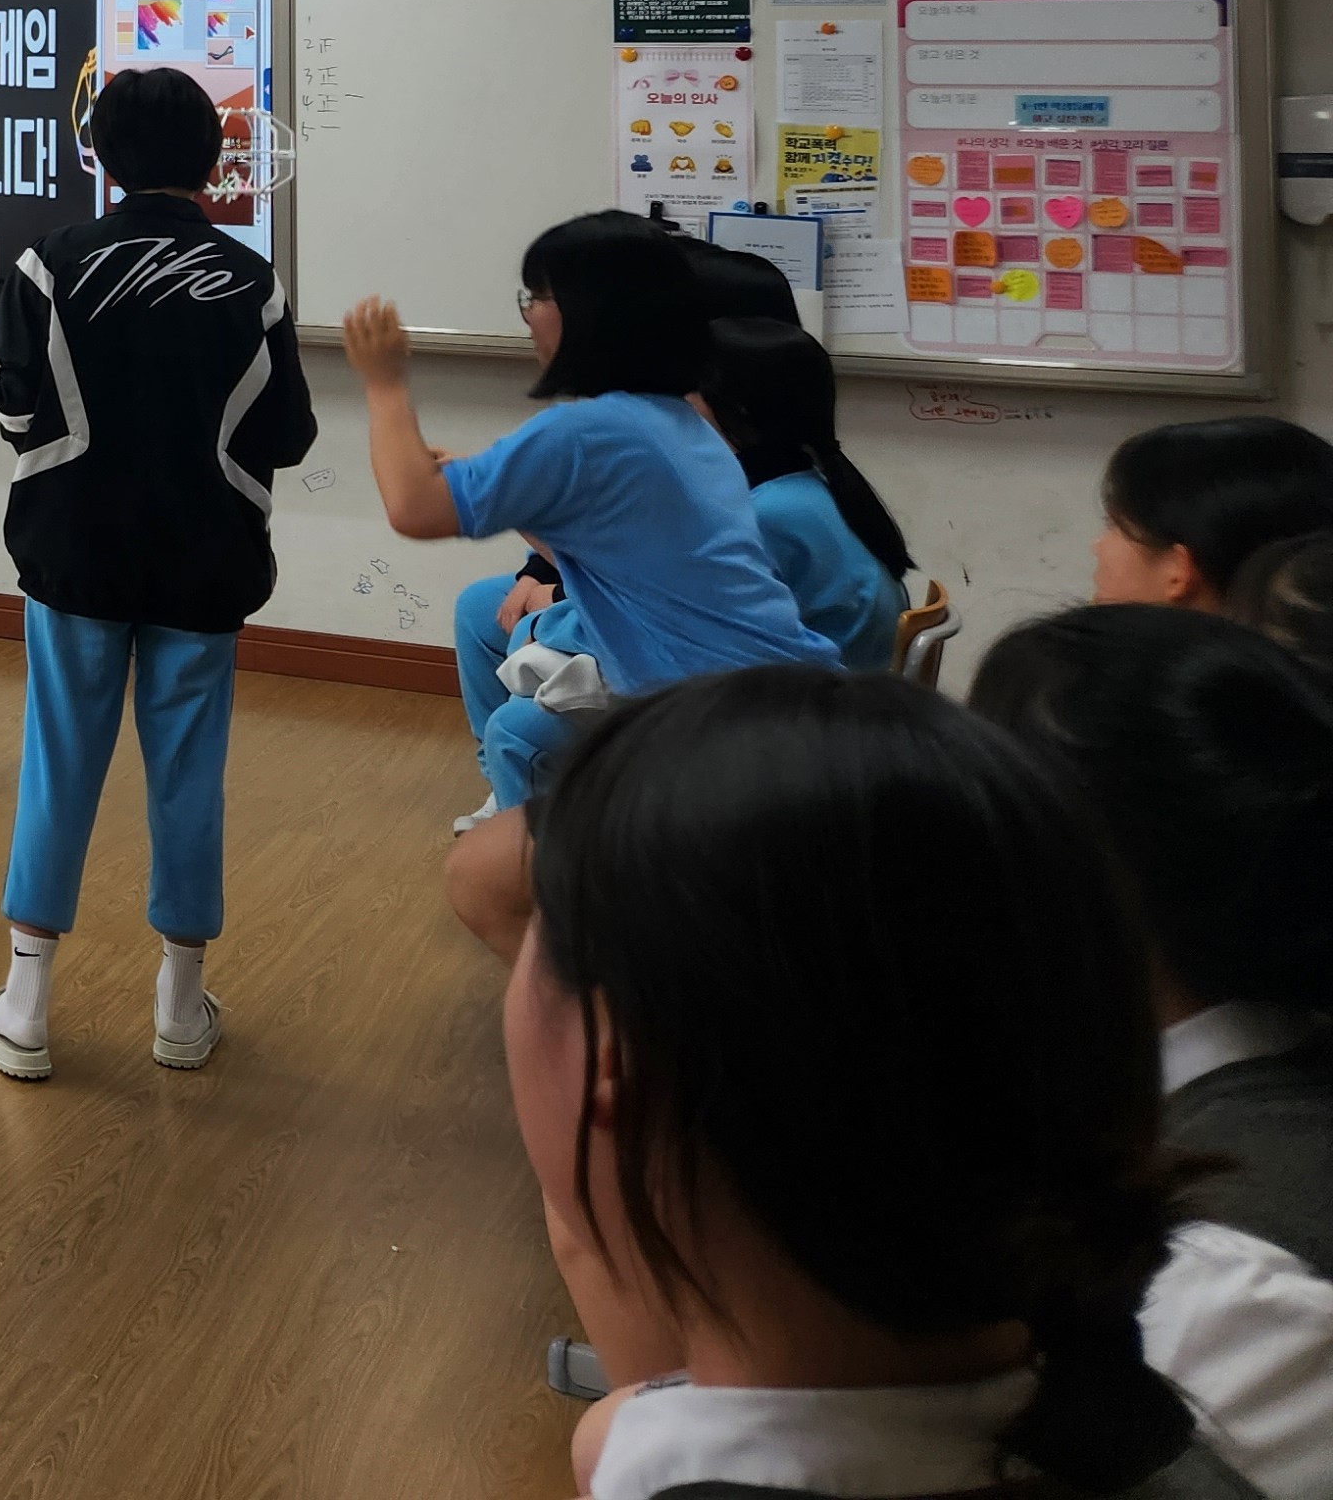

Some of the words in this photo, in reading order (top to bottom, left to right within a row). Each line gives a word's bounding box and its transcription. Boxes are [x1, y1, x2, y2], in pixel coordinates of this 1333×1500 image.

[646, 92, 687, 105] 오늘의
[690, 92, 719, 105] 인사
[785, 137, 837, 151] 학교폭력
[987, 137, 1009, 149] 생각
[784, 151, 810, 164] 함께
[68, 237, 256, 323] Nike
